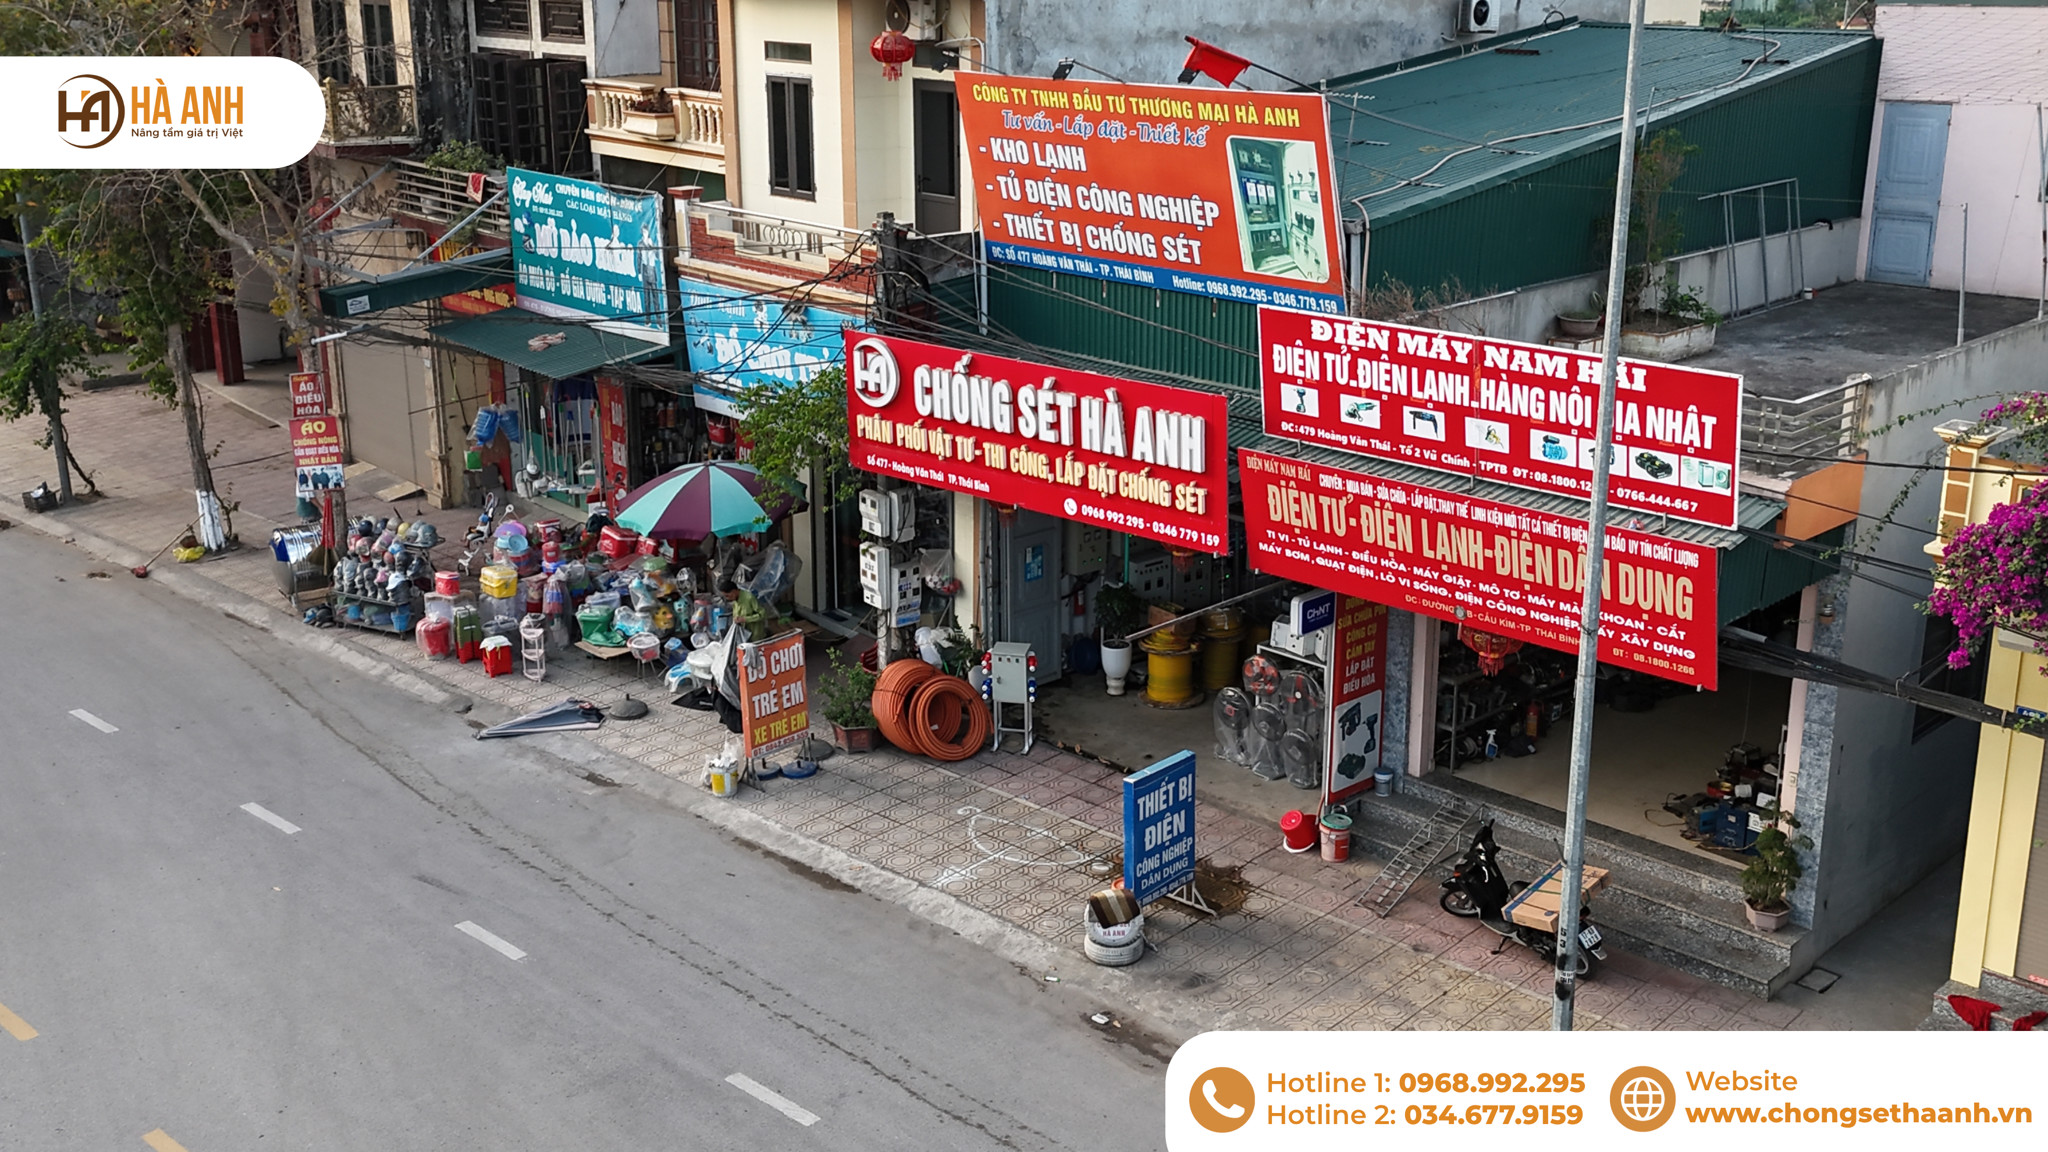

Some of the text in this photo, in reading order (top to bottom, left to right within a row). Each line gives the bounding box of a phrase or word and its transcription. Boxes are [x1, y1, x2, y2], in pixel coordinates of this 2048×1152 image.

[972, 82, 1300, 128] CÔNG TY TNHH ĐẦU TƯ THƯƠNG MẠI HÀ ANH
[1002, 109, 1210, 147] Tư vấn Lắp đặt Thiết kế
[989, 137, 1088, 174] KHO LẠNH
[996, 169, 1220, 232] TỦ ĐIỆN CÔNG NGHIỆP
[1003, 210, 1202, 265] THIẾT BỊ CHỐNG SÉT
[991, 245, 1338, 314] ĐC: SỐ 477 HOÀNG VĂN THÁI THÁI BÌNH Hotline: 0968.992.295 0346.779.159
[1310, 319, 1390, 352] ĐIỆN
[1397, 332, 1473, 364] MÁY
[1484, 345, 1568, 380] NAM
[297, 404, 321, 415] HÒA
[299, 381, 314, 392] ÁO
[1273, 340, 1717, 453] ĐIỆN NỘI ỊA NHẬT
[301, 420, 326, 436] ÁO
[913, 353, 1206, 474] CHỐNG SÉT HÀ ANH
[856, 412, 1208, 516] PHÂN PHỐI VẬT CÔNG, LẮP ĐẶT CHỐNG SÉT
[876, 458, 973, 488] 477 Hoàng Thái Thái
[1317, 429, 1699, 512] Hoàng Văn Thái Chính TPTB 0766.444.667
[1081, 504, 1220, 547] 0968 992 295 0346 779 159
[1280, 462, 1673, 563] NAM LINH CHẤT
[1267, 480, 1318, 534] ĐIỆN
[1319, 494, 1354, 537] TỬ
[1360, 501, 1414, 558] ĐIỆN
[1618, 562, 1694, 621] DỤNG
[1258, 541, 1282, 555] MÁY
[1315, 556, 1346, 572] QUẠT
[1380, 571, 1396, 583] LÒ
[1455, 590, 1483, 607] ĐIỆN
[1486, 600, 1527, 617] CÔNG
[1621, 632, 1650, 648] XÂY
[1653, 641, 1696, 659] DỰNG
[1266, 530, 1686, 641] TI VI TỦ LẠNH ĐIỀU HÒA MÁY GIẶT MÔ TƠ MÁY CẮT
[770, 642, 804, 675] CHƠI
[752, 679, 804, 720] TRẺ EM
[754, 725, 768, 745] XE
[769, 711, 789, 740] TRẺ
[790, 711, 807, 732] EM
[1137, 773, 1193, 822] THIẾT BỊ
[1144, 809, 1186, 852] ĐIỆN
[1136, 836, 1193, 878] CÔNG NGHIỆP
[1141, 872, 1161, 890] DÂN
[1163, 856, 1189, 877] DỤNG
